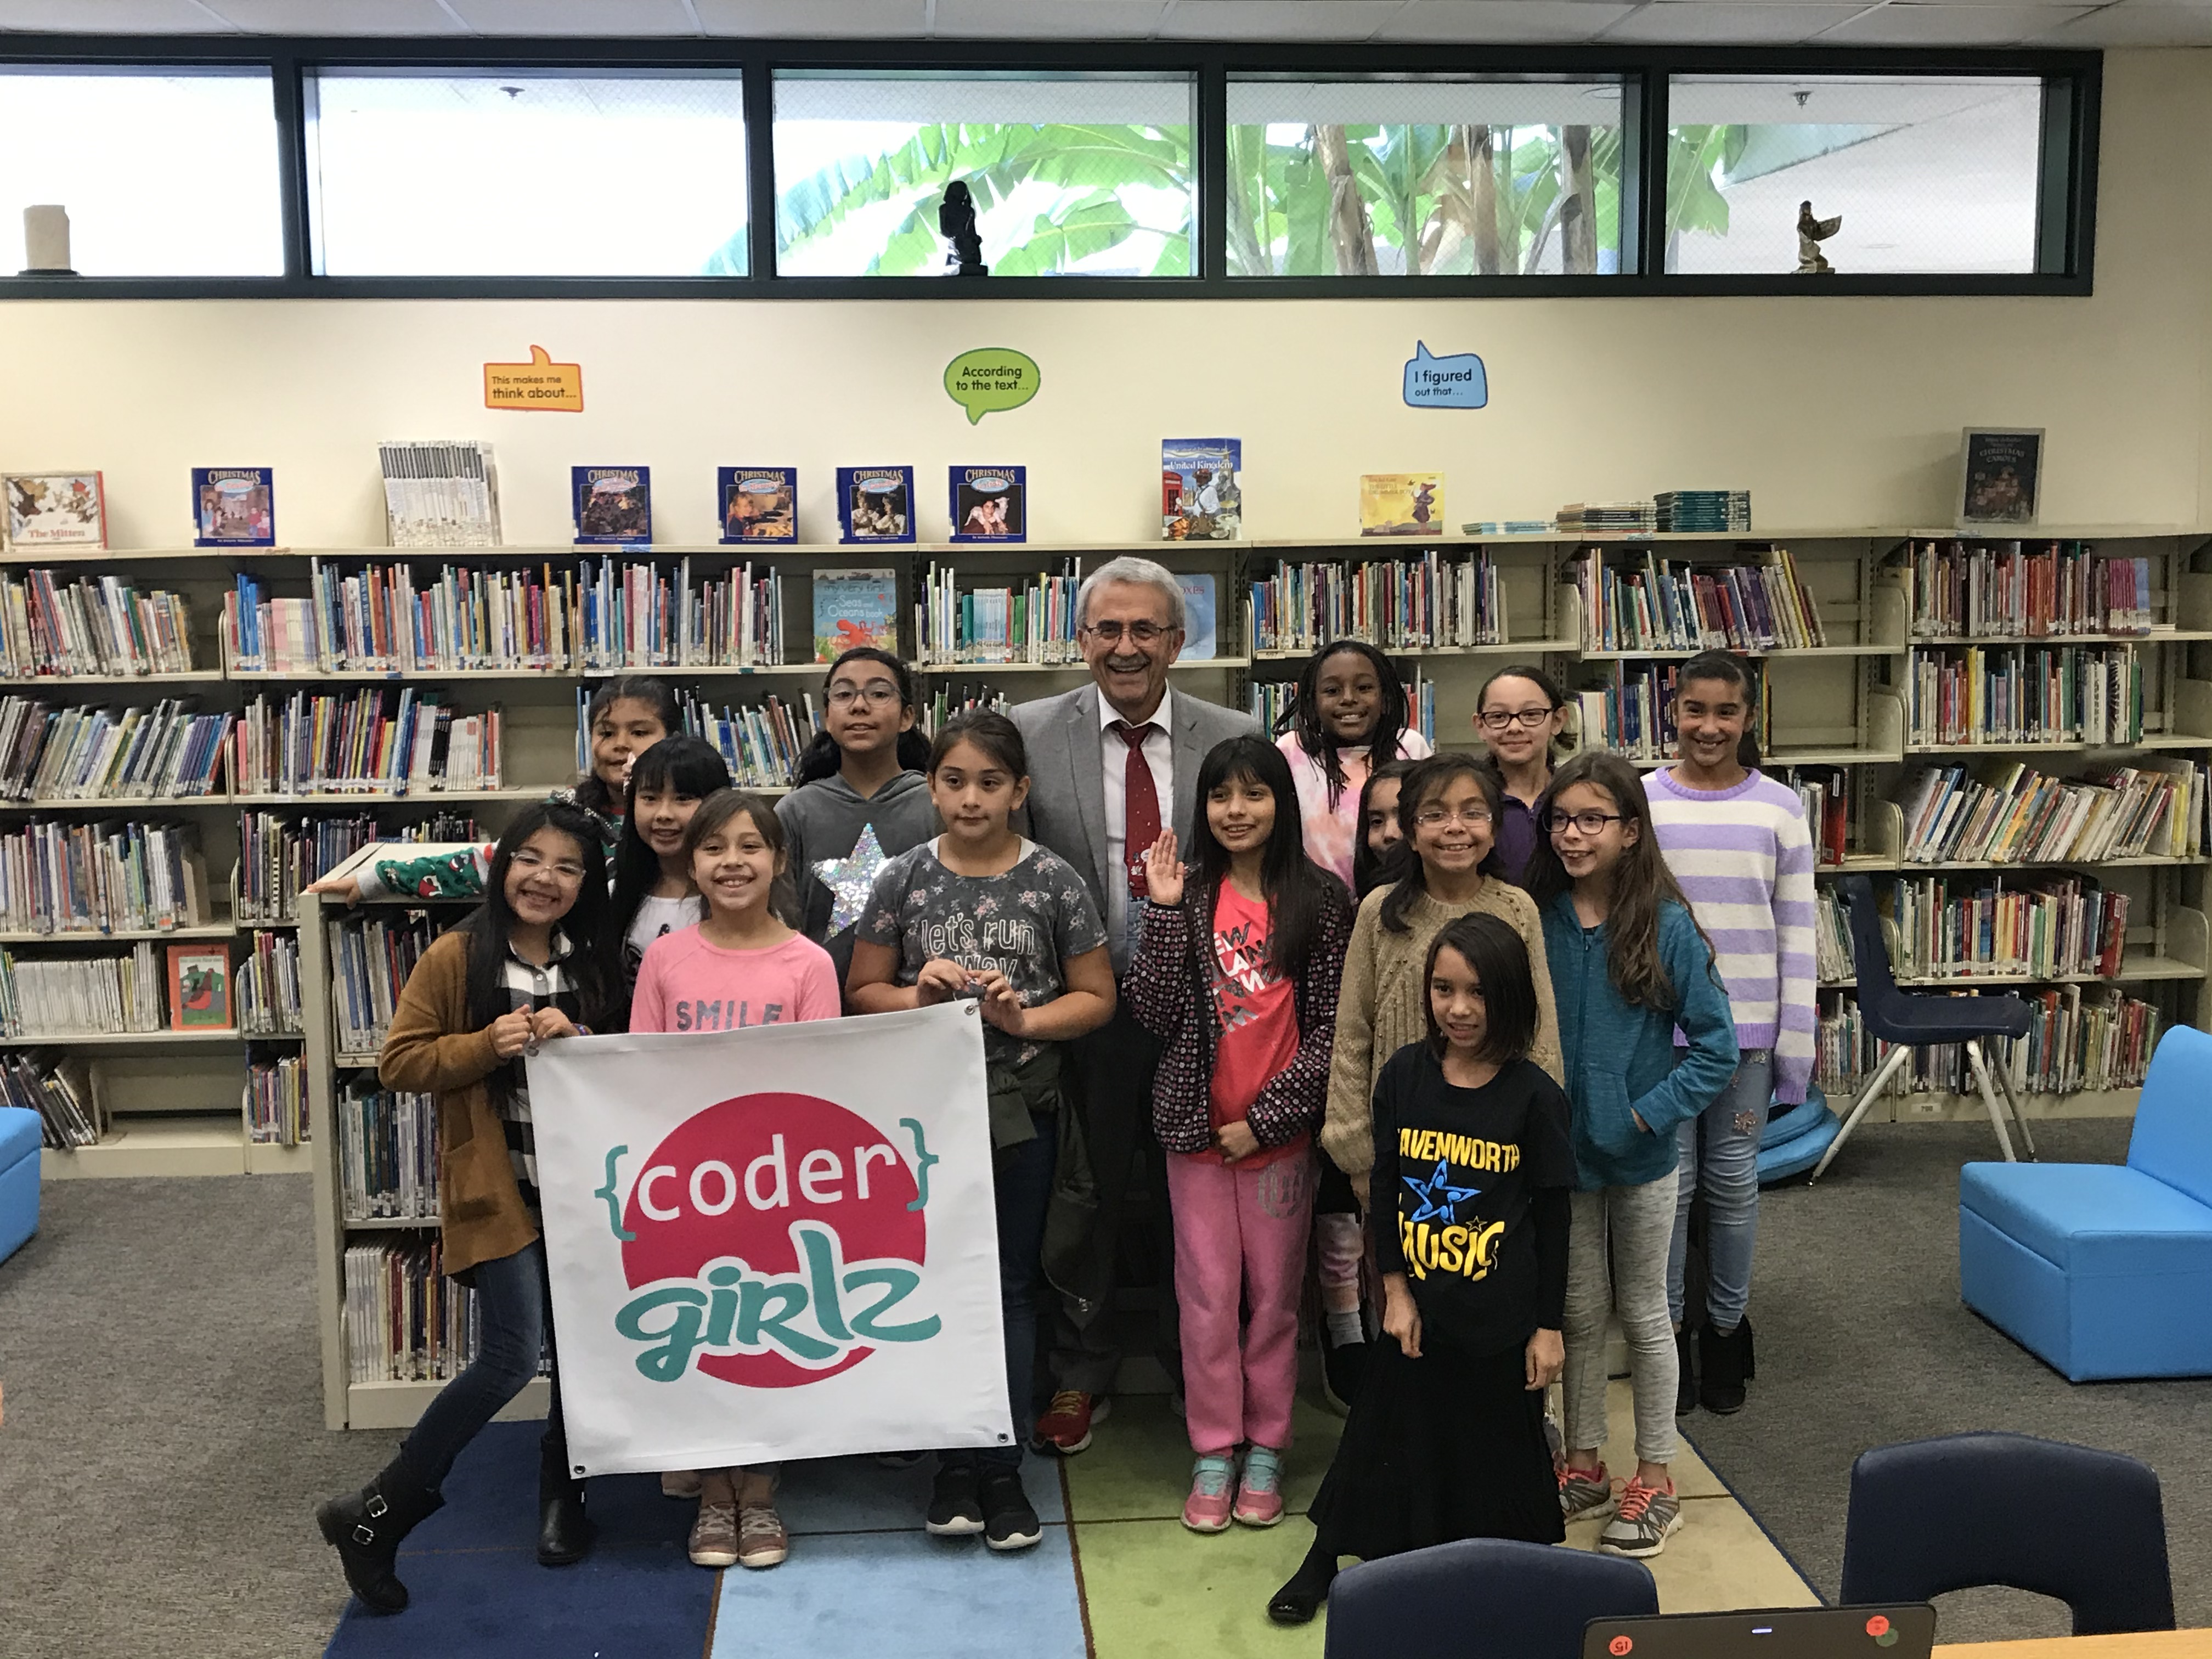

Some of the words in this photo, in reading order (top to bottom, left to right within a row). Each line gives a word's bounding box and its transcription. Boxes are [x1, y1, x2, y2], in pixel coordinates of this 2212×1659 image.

[962, 365, 1022, 380] According
[1414, 371, 1419, 383] I
[1422, 368, 1472, 385] figured
[492, 375, 511, 385] This
[512, 375, 544, 384] makes
[956, 380, 969, 391] to
[971, 379, 991, 391] the
[492, 387, 524, 399] think
[1415, 388, 1431, 397] out
[1170, 460, 1195, 470] United
[1197, 460, 1233, 471] Kingdom
[208, 470, 261, 485] CHRISTMAS
[588, 470, 639, 484] CHRISTMAS
[734, 470, 786, 485] CHRISTMAS
[853, 470, 904, 484] CHRISTMAS
[965, 469, 1015, 483] CHRISTMAS
[28, 529, 47, 538] The
[50, 529, 85, 538] Mitten
[824, 585, 840, 594] my
[842, 584, 864, 594] very
[866, 583, 887, 592] first
[839, 595, 862, 607] Seas
[827, 605, 865, 617] Oceans
[865, 608, 883, 618] book
[921, 912, 974, 958] let's
[984, 919, 1035, 955] run
[1398, 1128, 1520, 1173] AVENWORTH
